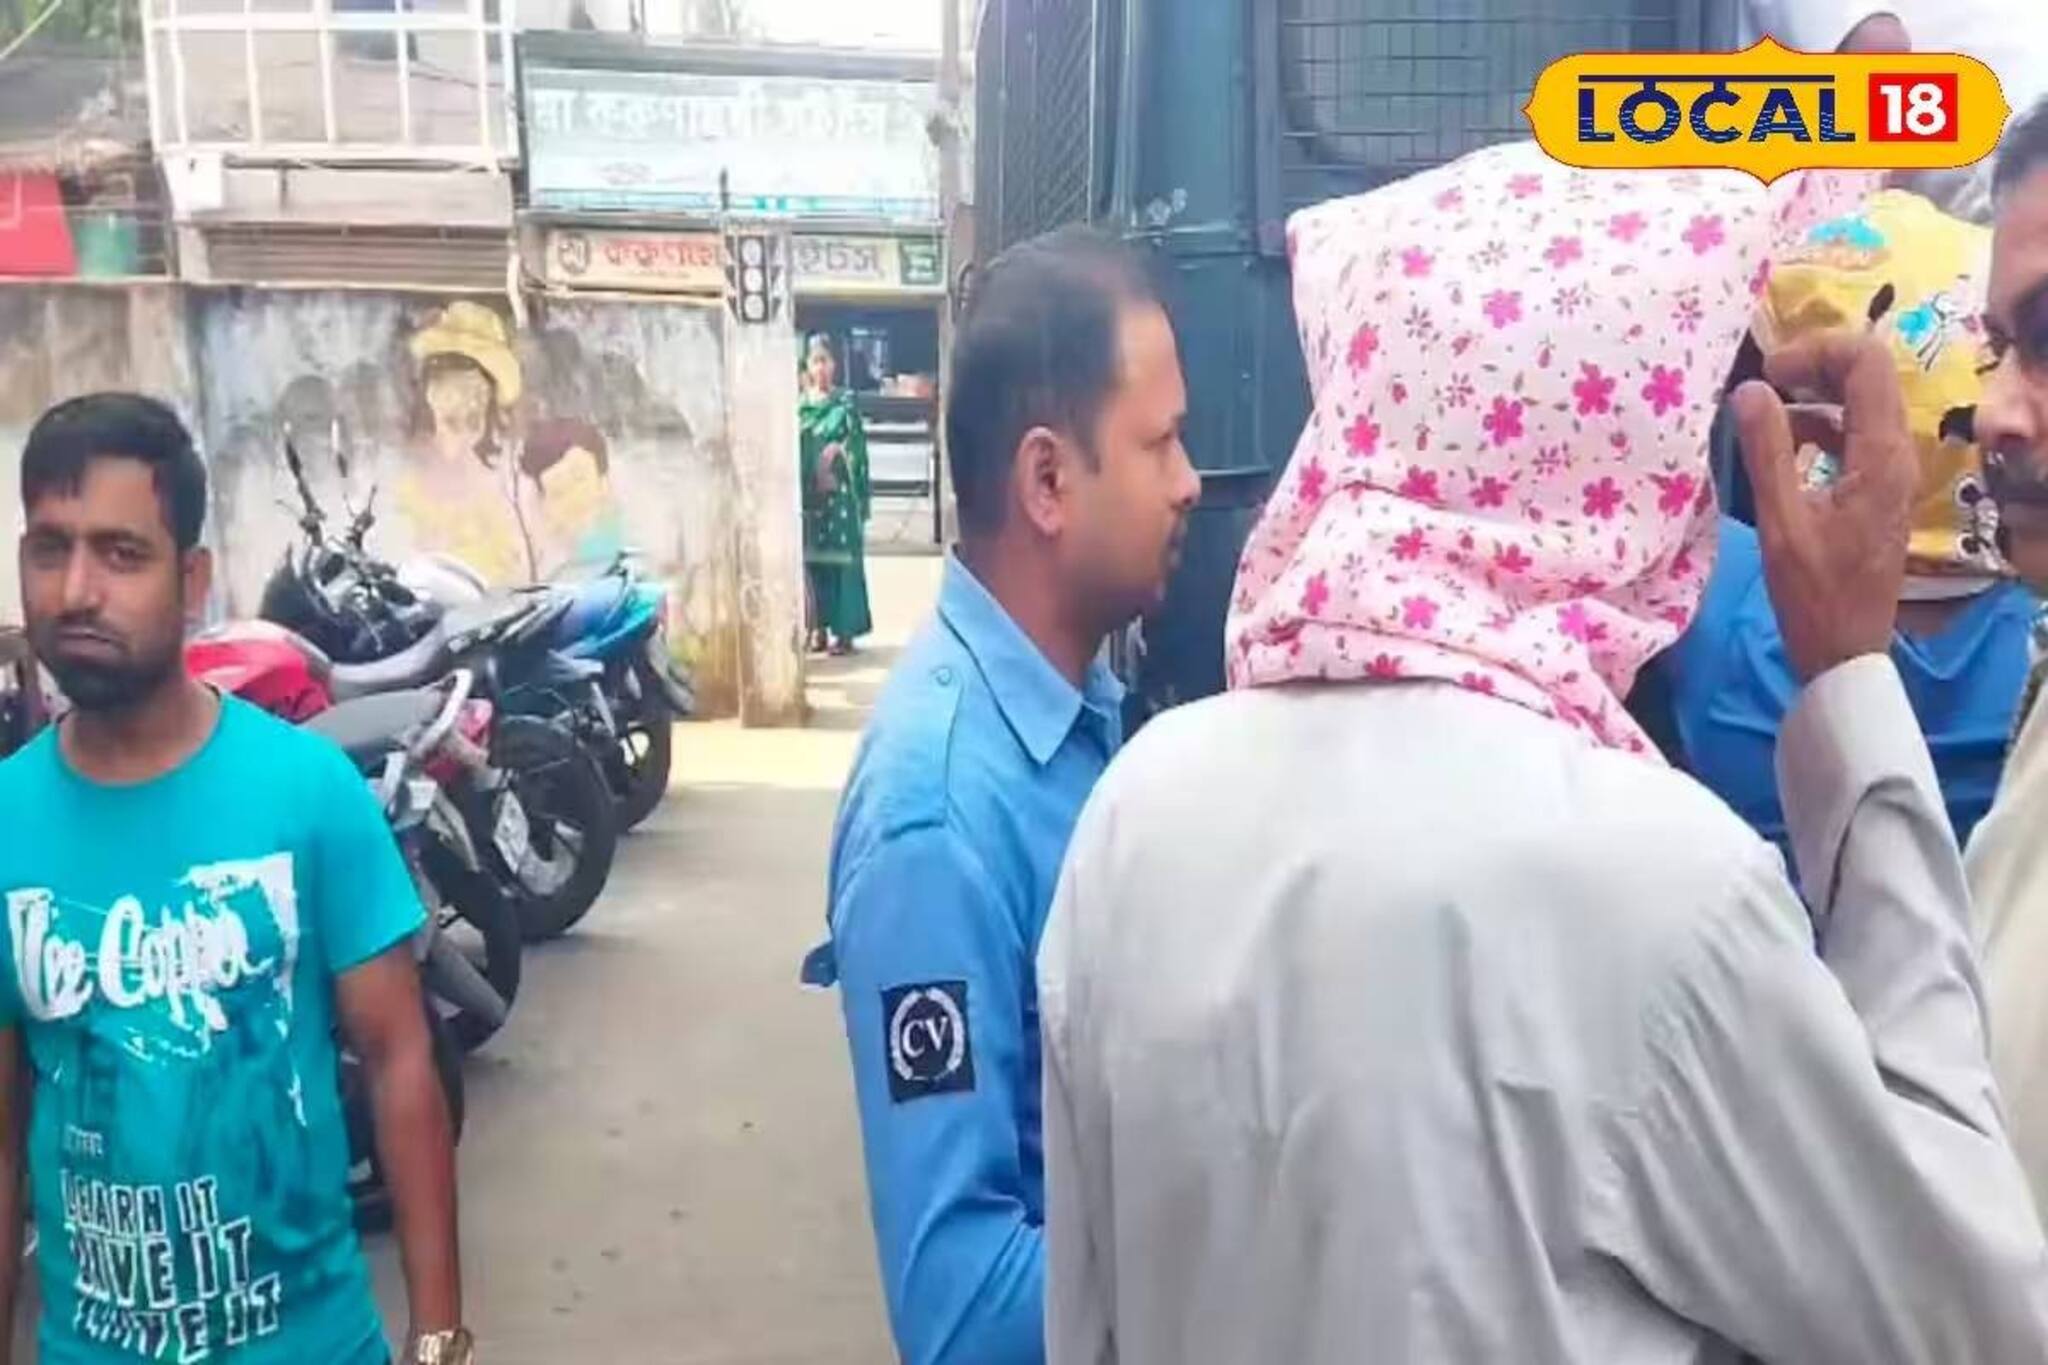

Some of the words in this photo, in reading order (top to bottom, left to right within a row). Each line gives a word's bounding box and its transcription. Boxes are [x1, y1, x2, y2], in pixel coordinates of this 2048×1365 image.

[902, 1016, 948, 1058] CV
[175, 1174, 218, 1233] IT
[191, 1215, 251, 1300] IT
[224, 1271, 281, 1346] IT
